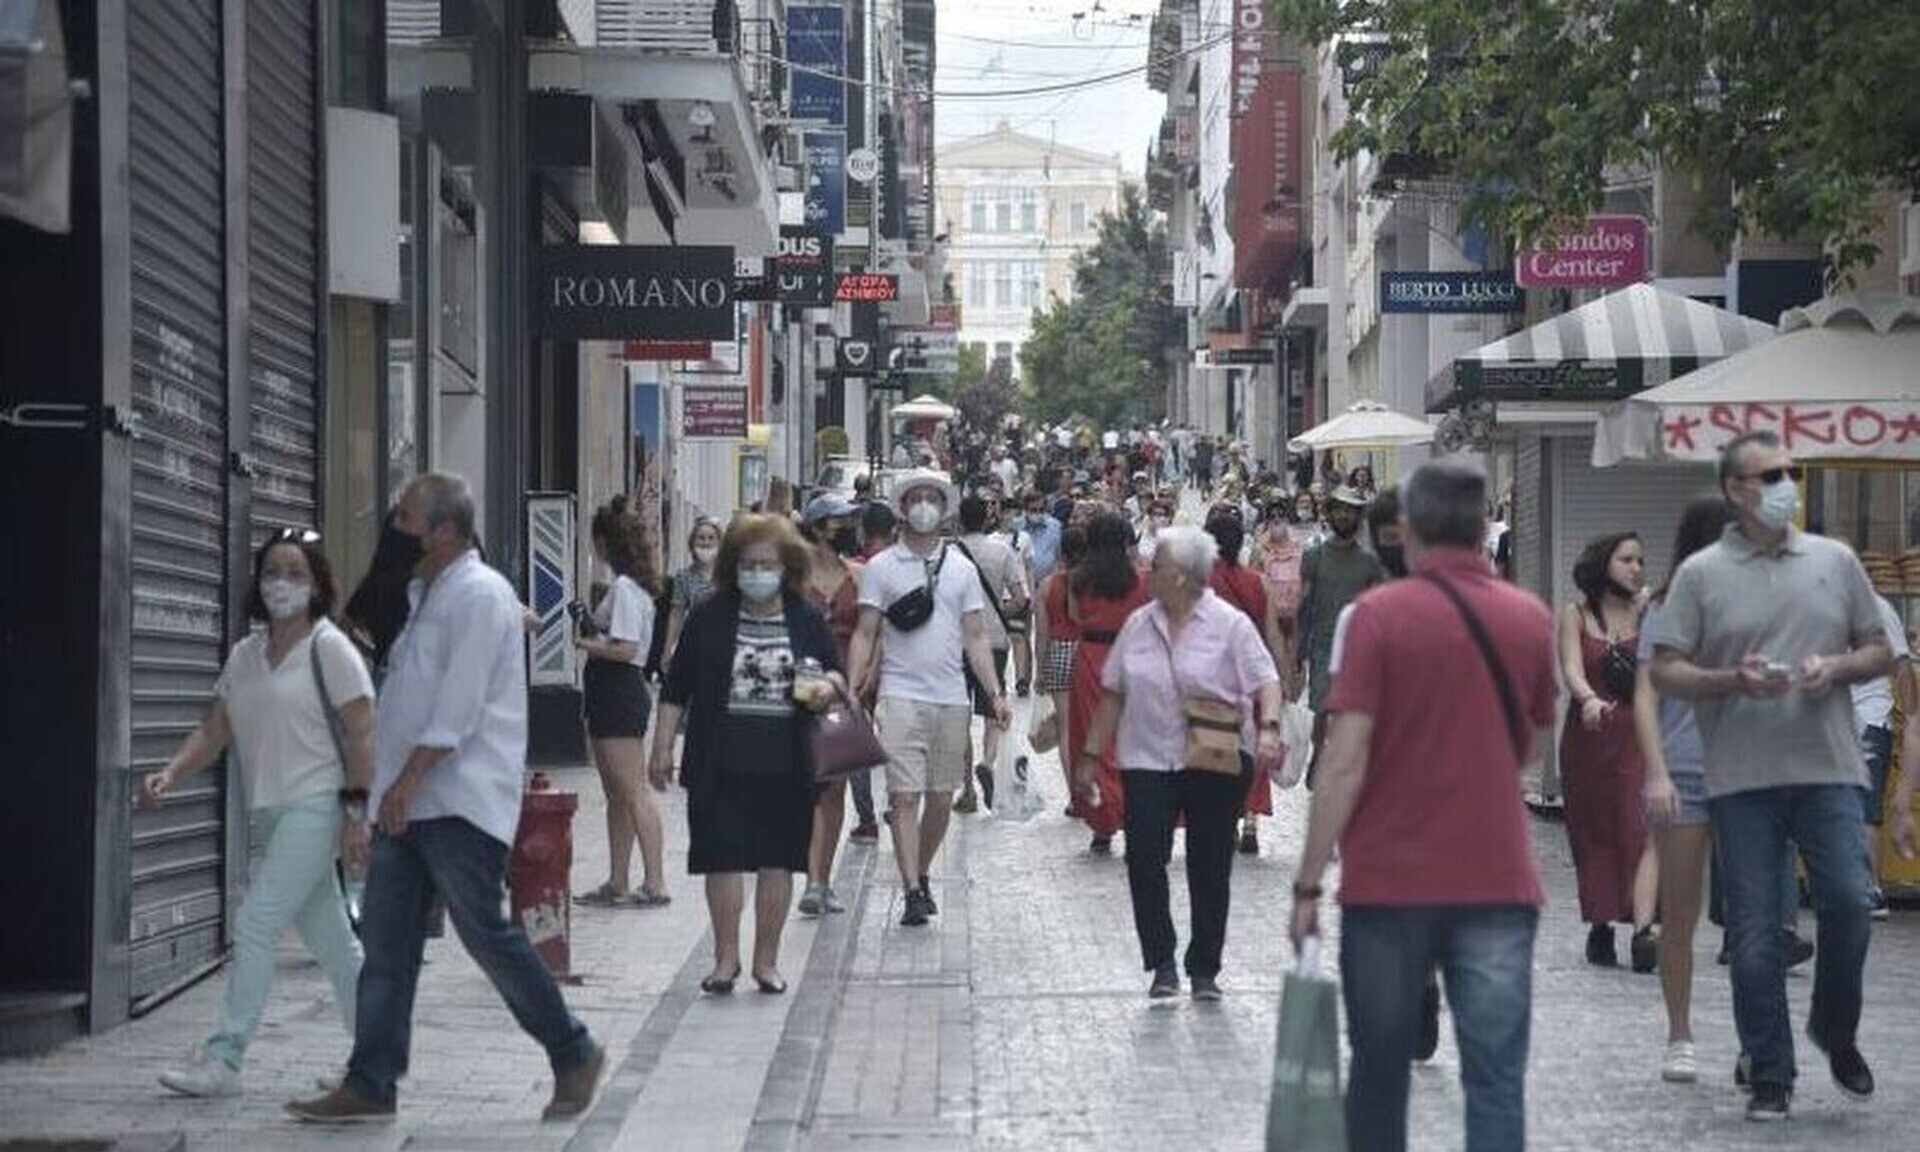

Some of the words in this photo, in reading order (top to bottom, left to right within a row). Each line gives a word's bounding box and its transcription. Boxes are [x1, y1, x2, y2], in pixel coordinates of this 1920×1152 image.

[1533, 226, 1635, 251] ondos
[1530, 252, 1624, 277] Center
[553, 276, 727, 307] ROMANO
[1388, 281, 1450, 297] BERTO
[1461, 281, 1516, 297] LUCCI
